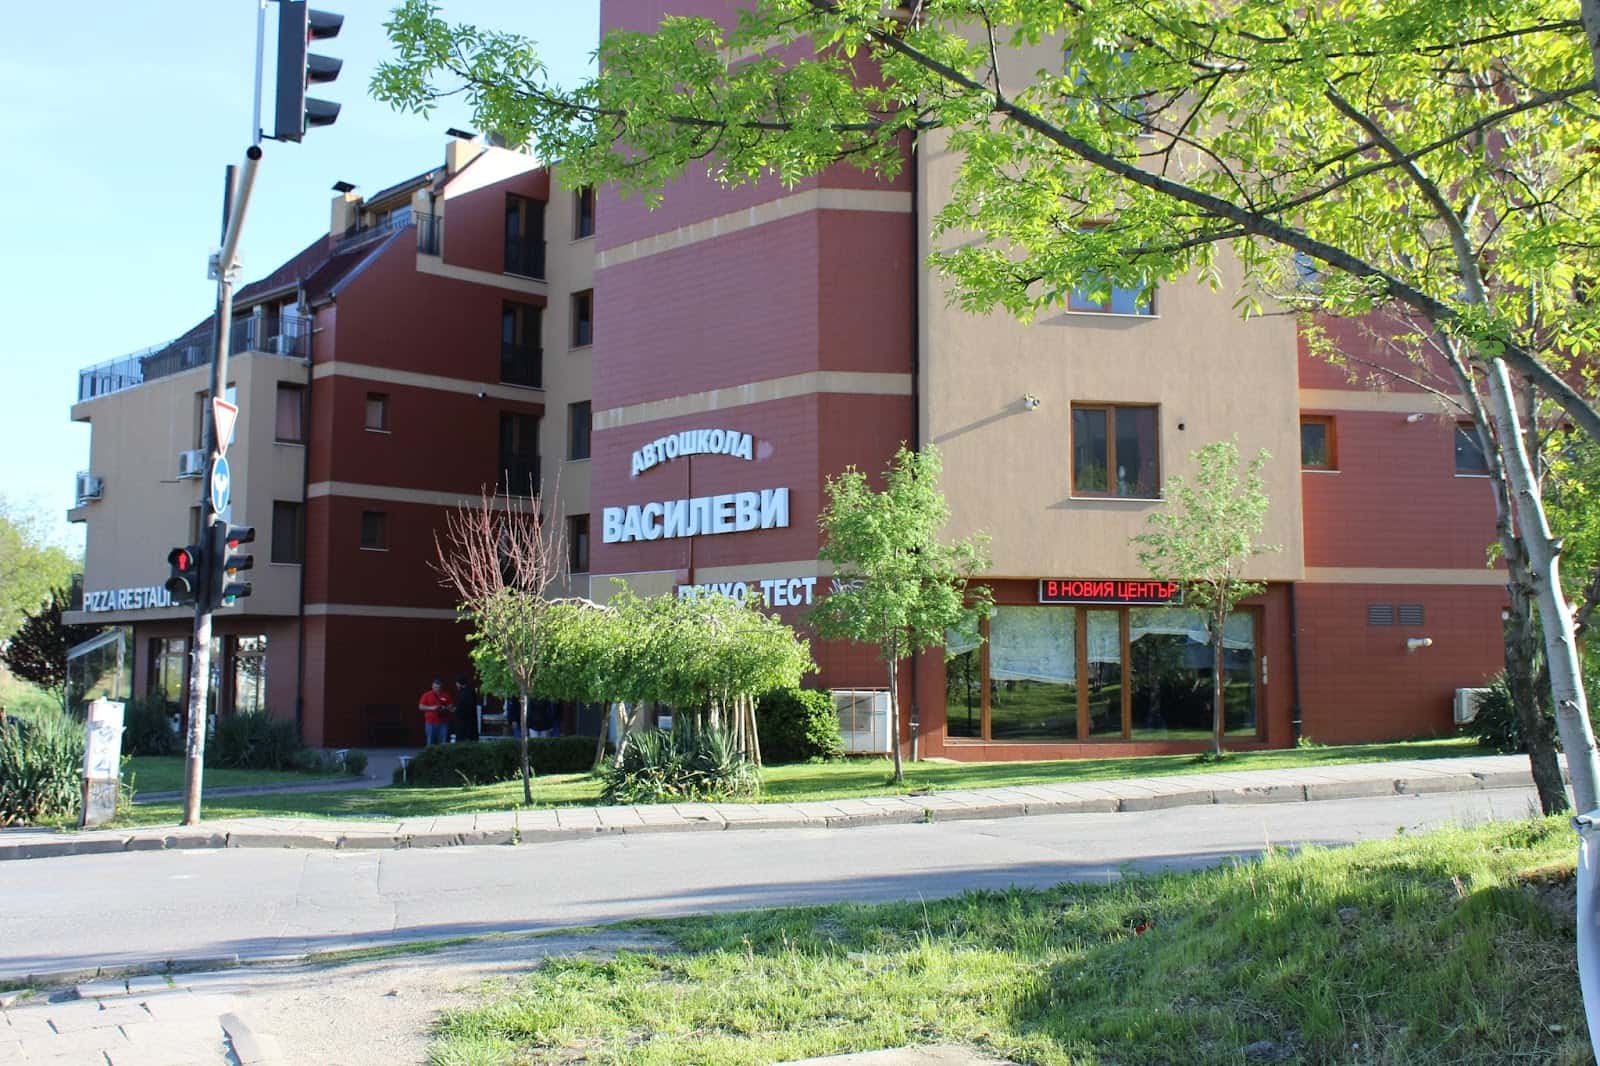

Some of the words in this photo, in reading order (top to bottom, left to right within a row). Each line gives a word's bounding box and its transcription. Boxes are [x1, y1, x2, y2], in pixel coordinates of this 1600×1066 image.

[631, 428, 753, 477] АВТОШКОЛА
[602, 487, 790, 543] ВАСИЛЕВИ
[83, 590, 116, 612] PIZZA
[1048, 581, 1058, 597] В
[1061, 581, 1114, 597] НОВИЯ
[1117, 582, 1177, 600] ЦЕНТЪР
